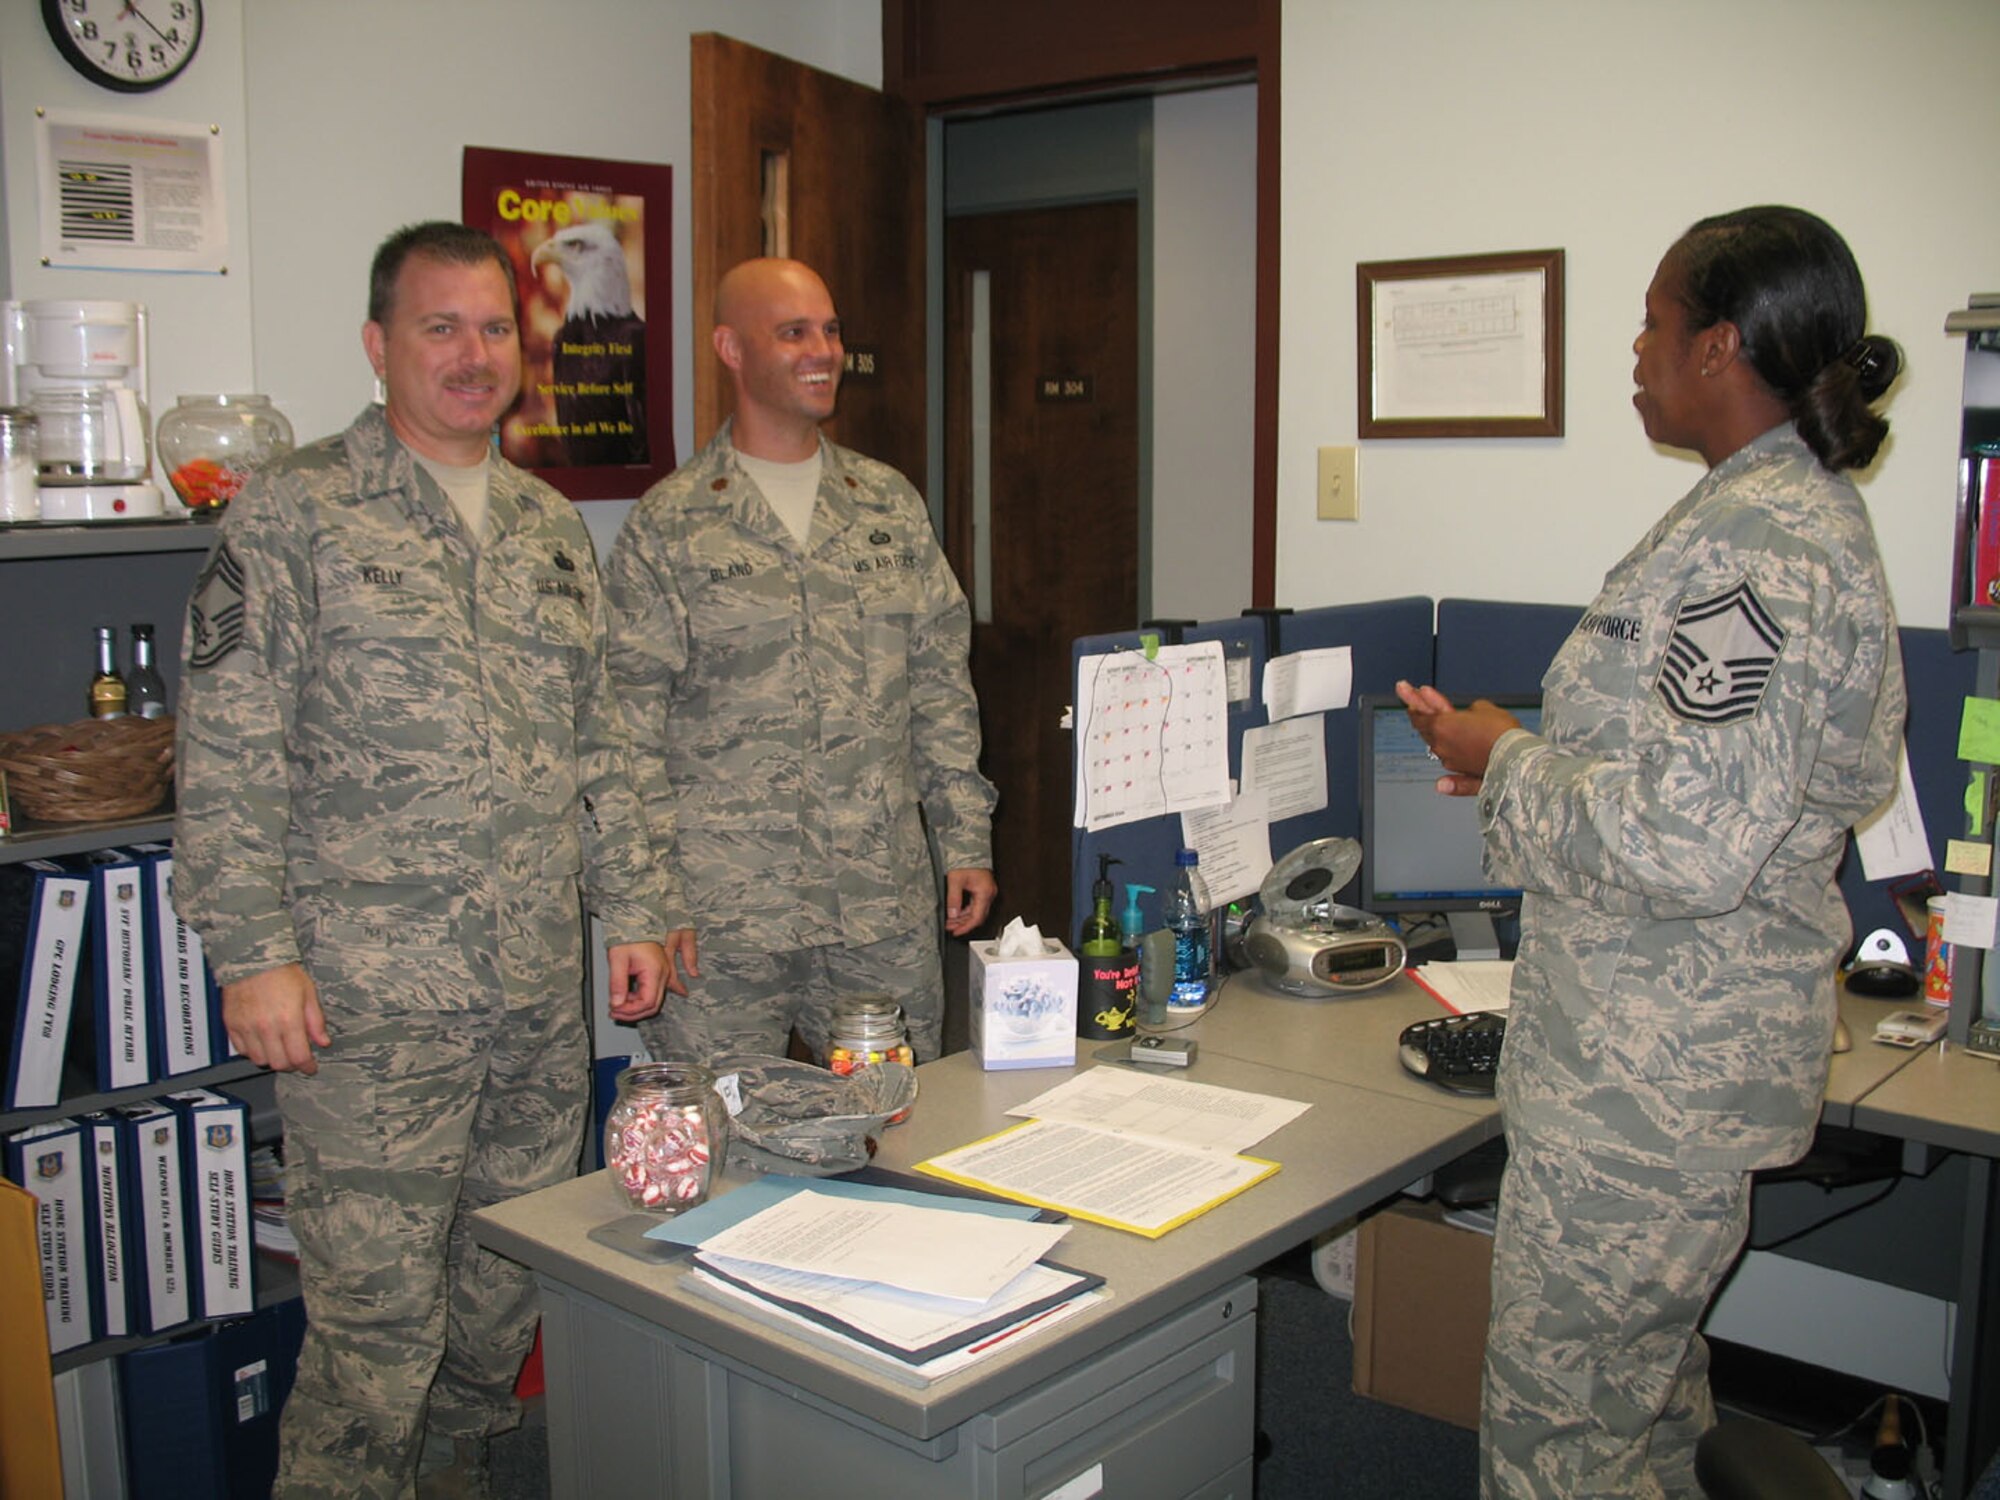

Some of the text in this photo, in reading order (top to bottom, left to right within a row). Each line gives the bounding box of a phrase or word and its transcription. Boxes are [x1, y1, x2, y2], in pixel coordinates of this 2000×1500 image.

[172, 2, 185, 20] 3
[83, 21, 98, 40] 8
[167, 28, 179, 42] 4
[104, 41, 116, 59] 7
[127, 50, 141, 69] 6
[150, 44, 164, 62] 5
[497, 189, 571, 226] Core
[562, 342, 633, 357] Integrity First
[858, 353, 875, 374] 305
[537, 382, 633, 395] Service Before Self
[1065, 381, 1084, 395] 304
[599, 422, 616, 433] We
[709, 562, 753, 583] BLAND
[853, 560, 869, 573] US
[875, 555, 894, 570] AIR
[363, 567, 401, 585] KELLY
[1598, 614, 1642, 642] FORCE
[1479, 900, 1501, 909] DELL
[54, 939, 66, 961] GPC
[47, 963, 62, 1010] LODGING
[176, 918, 195, 1056] WARDS AND DECORATIONS
[123, 988, 133, 1021] PUBLIC
[124, 1024, 135, 1063] AFFAIRS
[102, 1166, 118, 1283] MUNITIONS ALLOCATION
[158, 1156, 169, 1197] WEAPONS
[164, 1231, 174, 1274] MEMBERS
[224, 1170, 239, 1289] HOME STATION TRAINING
[212, 1231, 223, 1265] GUIDES
[55, 1199, 71, 1323] HOME STATION TRAINING
